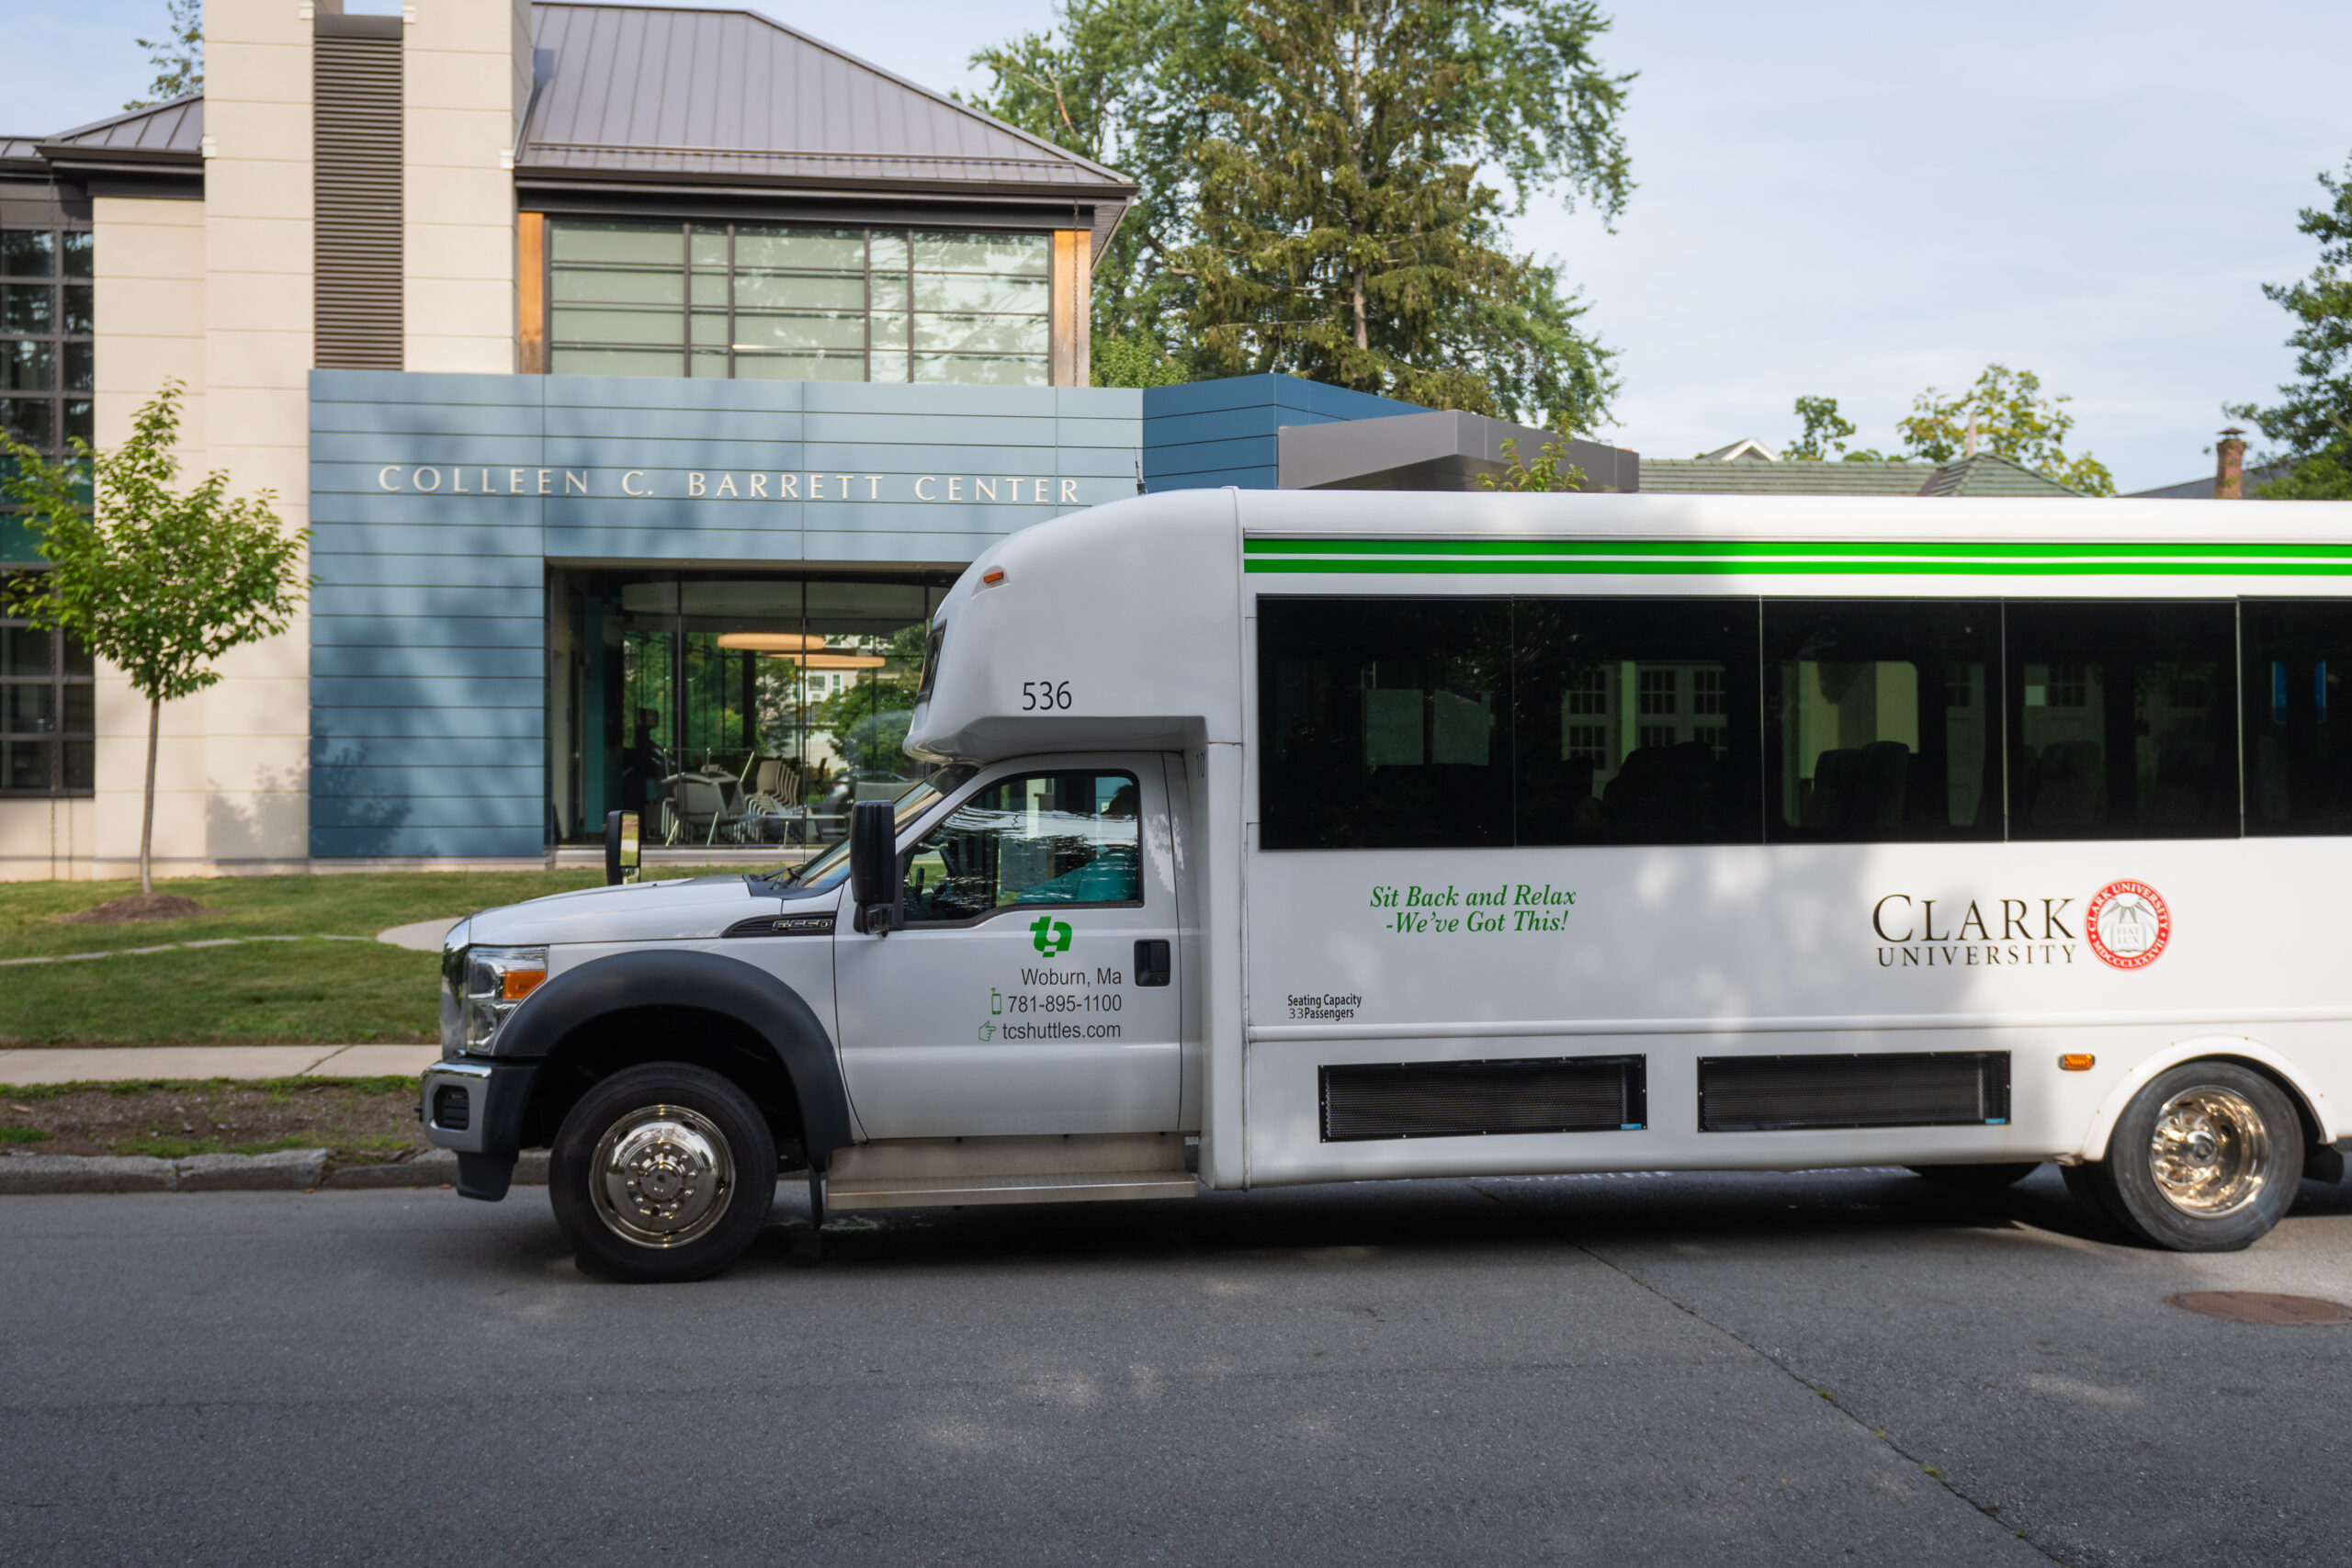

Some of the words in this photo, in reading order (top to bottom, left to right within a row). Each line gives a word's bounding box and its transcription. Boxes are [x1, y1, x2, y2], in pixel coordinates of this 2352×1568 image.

[378, 465, 588, 495] COLLEEN
[621, 471, 654, 497] C.
[689, 472, 884, 501] BARRETT
[914, 477, 1080, 503] CENTER
[1023, 681, 1072, 711] 536
[1370, 886, 1399, 908] Sit
[1406, 885, 1459, 907] Back
[1465, 885, 1508, 906] and
[1512, 885, 1577, 906] Relax
[2086, 889, 2111, 931] CLARK
[2111, 883, 2169, 930] UNIVERSITY
[1466, 910, 1506, 932] Got
[1514, 909, 1569, 931] This!
[1872, 894, 2076, 943] CLARK
[1877, 944, 2076, 967] UNIVERSITY
[1021, 967, 1091, 987] Woburn,
[1097, 967, 1122, 985] Ma
[1008, 994, 1122, 1013] 781-895-1100
[1288, 994, 1321, 1009] Seating
[1323, 993, 1362, 1009] Capacity
[1002, 1021, 1122, 1040] tcshuttles.com
